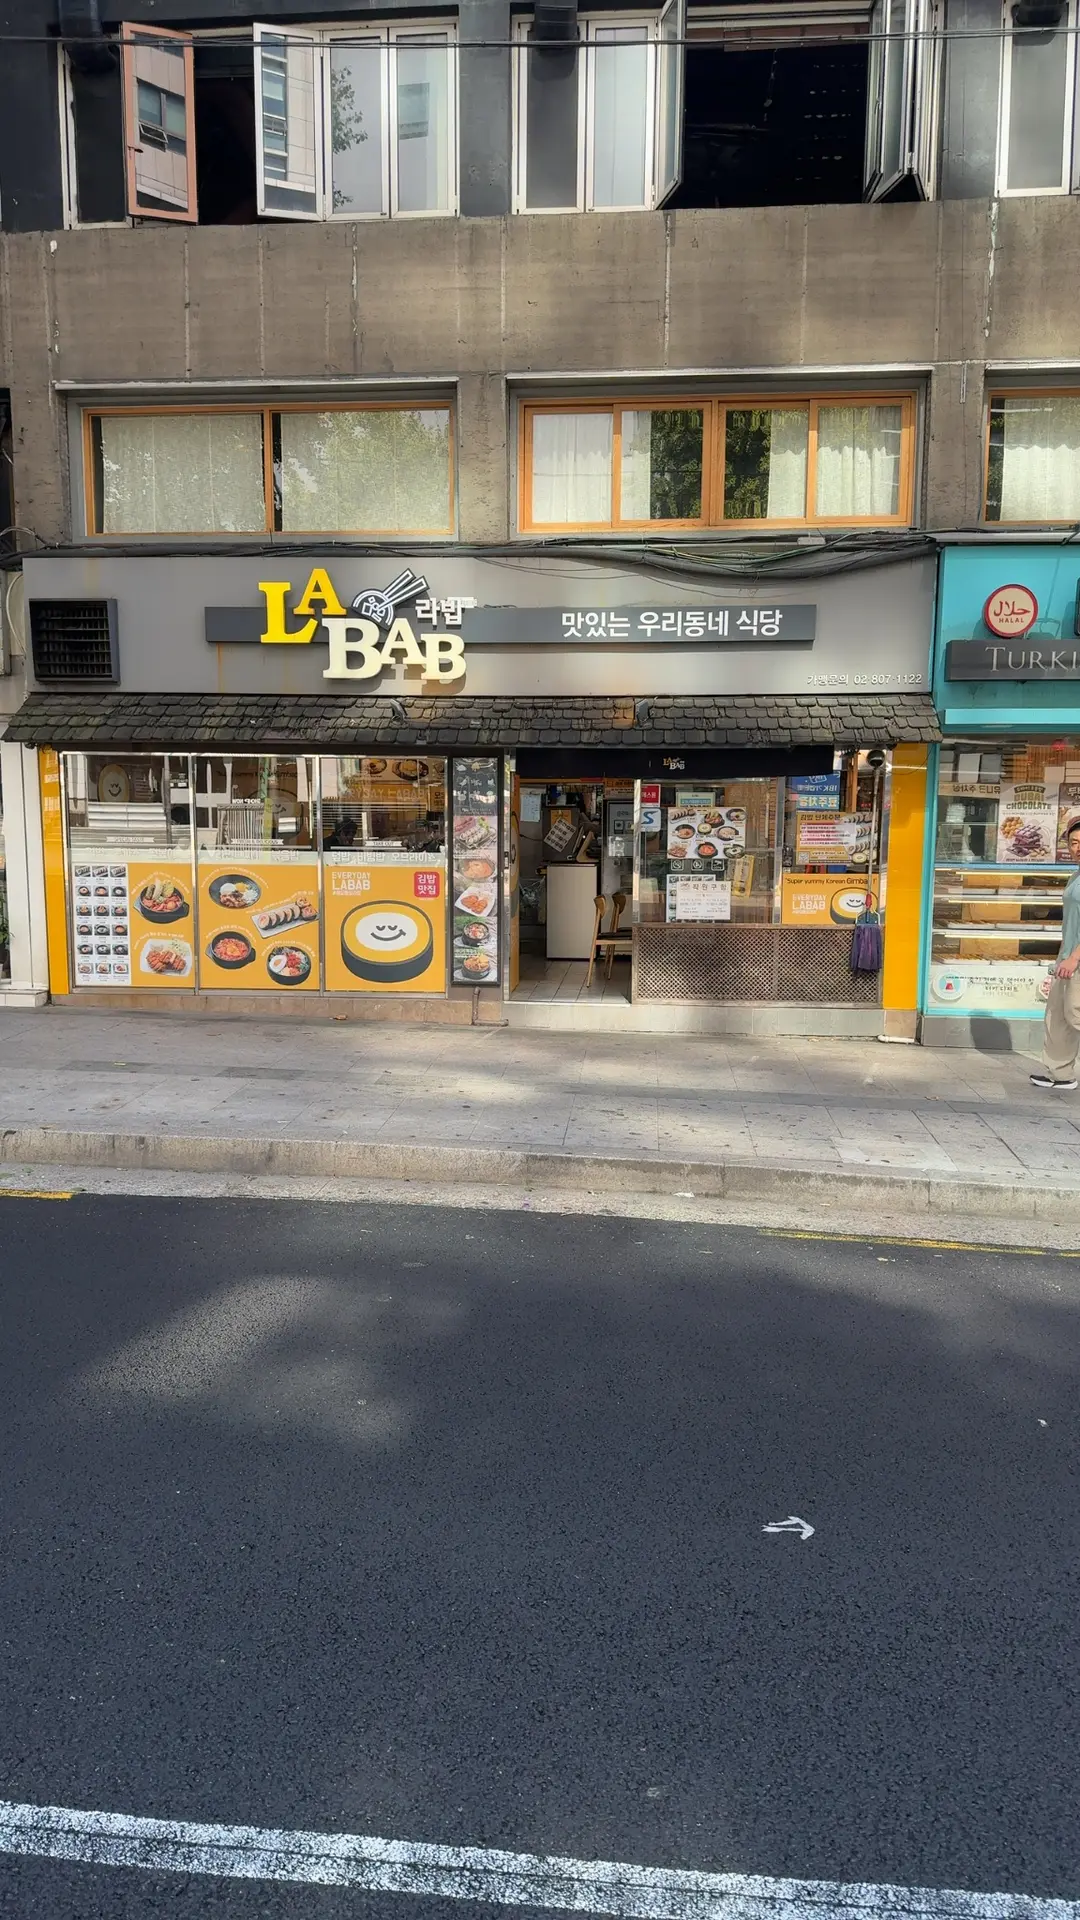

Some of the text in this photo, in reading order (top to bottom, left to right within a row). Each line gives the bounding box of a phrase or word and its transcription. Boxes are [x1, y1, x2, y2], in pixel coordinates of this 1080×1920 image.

[415, 597, 464, 626] 라밥
[993, 601, 1031, 617] حلال
[561, 609, 783, 638] 맛있는 우리동네 식당
[984, 646, 1080, 672] TURKI
[807, 673, 849, 685] 가맹문의
[1005, 801, 1052, 810] CHOCOLATE
[332, 879, 371, 890] LABAB
[417, 874, 437, 884] 김밥
[417, 884, 437, 895] 맛집
[792, 900, 826, 910] LABAB
